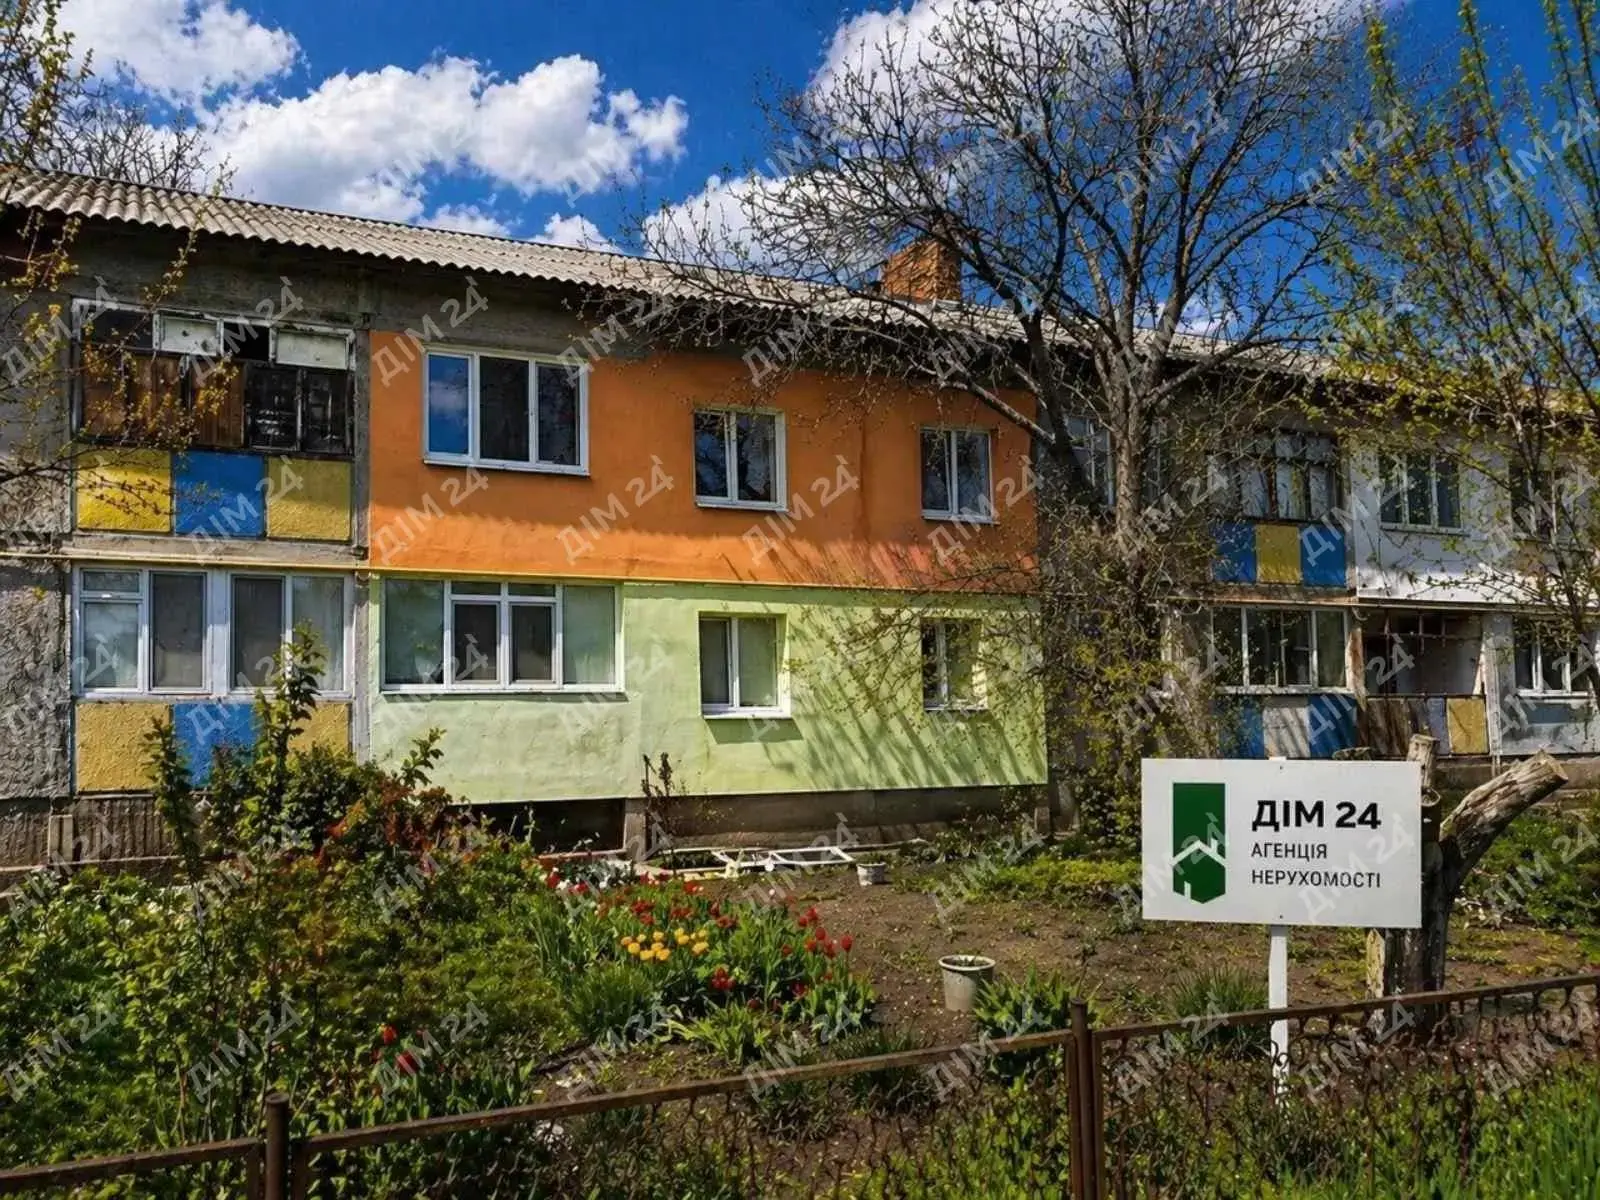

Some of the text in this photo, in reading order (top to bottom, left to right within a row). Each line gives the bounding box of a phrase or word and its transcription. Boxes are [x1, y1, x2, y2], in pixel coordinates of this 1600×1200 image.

[1251, 799, 1382, 832] ДІМ 24
[1251, 842, 1328, 862] АГЕНЦІЯ
[1251, 869, 1381, 888] НЕРУХОМОСТІ
